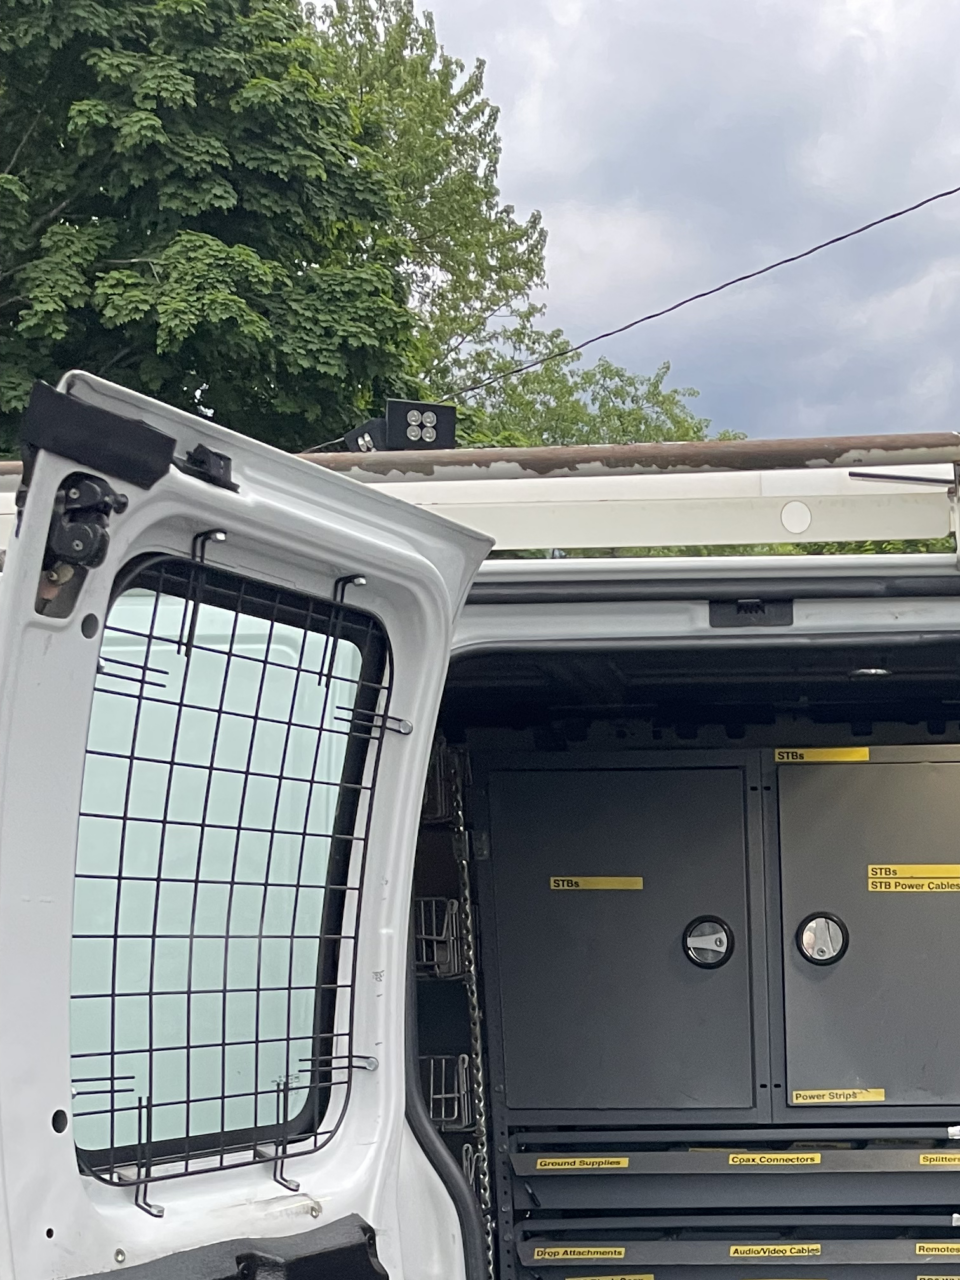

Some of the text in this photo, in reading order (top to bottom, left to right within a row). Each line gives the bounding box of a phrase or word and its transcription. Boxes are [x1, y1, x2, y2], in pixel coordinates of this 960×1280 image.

[777, 751, 804, 761] STBs
[871, 867, 898, 876] STBs
[553, 879, 580, 888] STBs
[871, 881, 960, 890] STB Power Cables
[795, 1091, 858, 1101] Power Strips
[539, 1159, 621, 1168] Ground Supplies
[731, 1155, 816, 1164] Coax Connectors
[536, 1249, 623, 1257] Drop Attachments
[732, 1246, 821, 1255] Audio/Video Cables
[918, 1245, 960, 1254] Remotes
